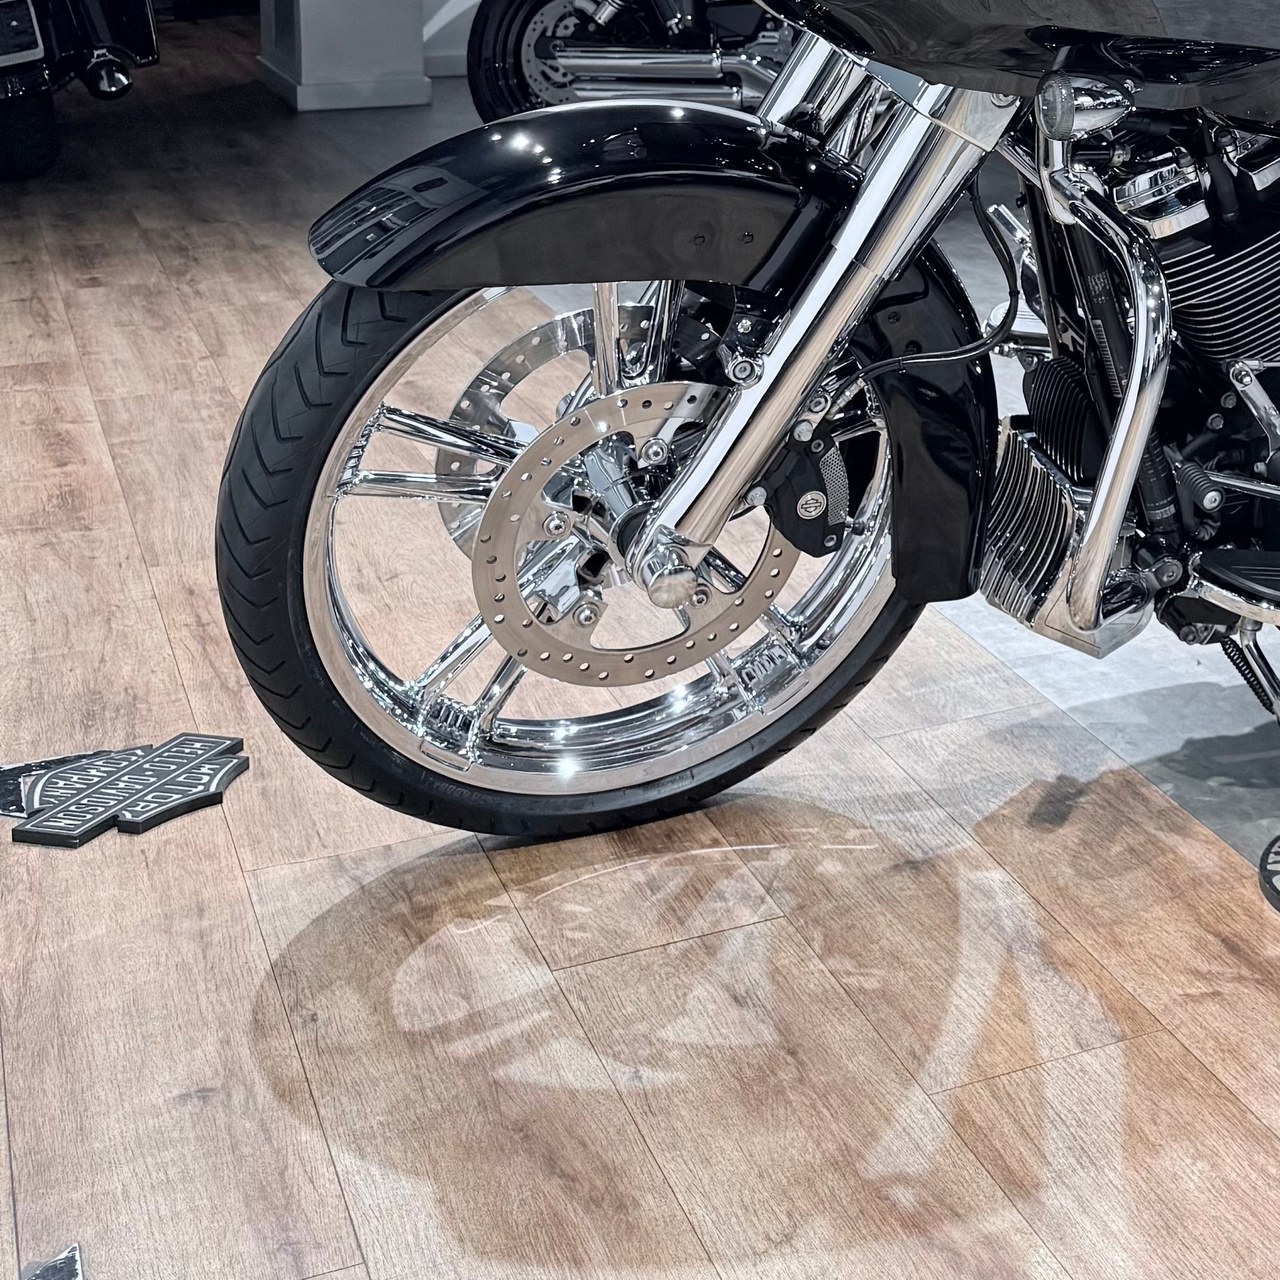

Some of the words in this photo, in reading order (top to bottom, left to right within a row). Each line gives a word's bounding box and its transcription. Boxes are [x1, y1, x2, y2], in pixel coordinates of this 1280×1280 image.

[143, 740, 216, 771] HELLO
[43, 774, 158, 828] DAVIDSON
[126, 762, 221, 812] MOTOR
